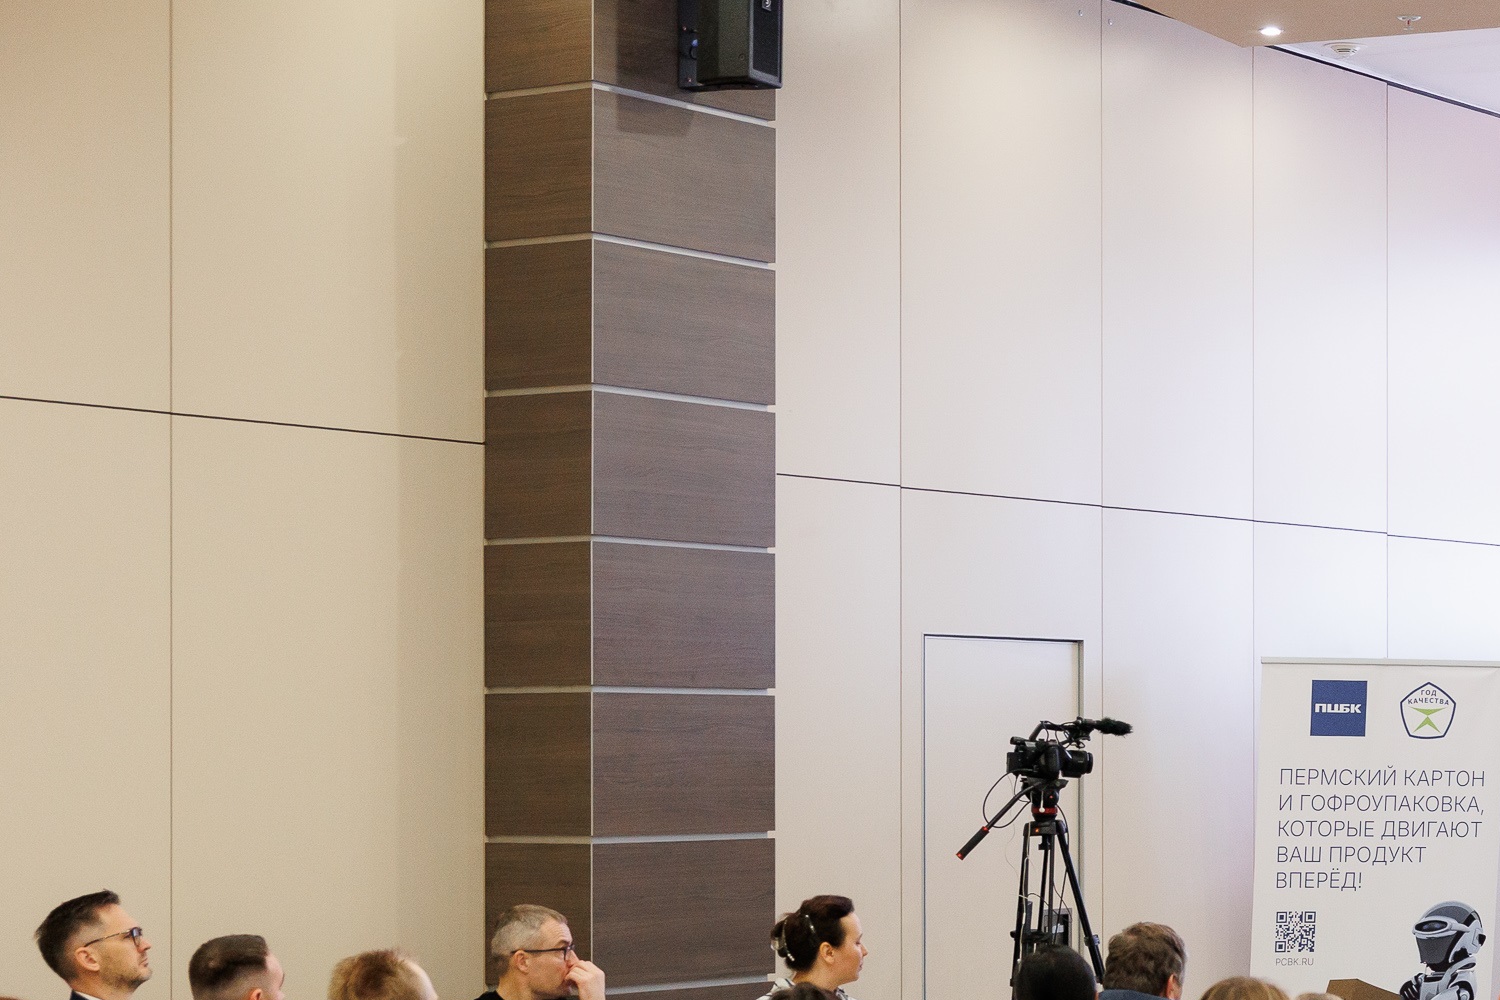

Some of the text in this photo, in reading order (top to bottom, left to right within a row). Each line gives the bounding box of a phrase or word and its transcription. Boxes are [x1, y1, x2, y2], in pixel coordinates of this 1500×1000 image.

[1407, 697, 1450, 706] КАЧЕСТВА
[1420, 689, 1437, 697] ГОД
[1314, 703, 1362, 714] ПЦБК
[1280, 765, 1485, 787] ПЕРМСКИЙ КАРТОН
[1279, 793, 1484, 816] И ГОФРОУПАКОВКА,
[1278, 820, 1483, 840] КОТОРЫЕ ДВИГАЮТ
[1276, 846, 1427, 866] ВАШ ПРОДУКТ
[1276, 868, 1362, 892] ВПЕРЁД!
[1275, 957, 1315, 967] PCBK.RU
